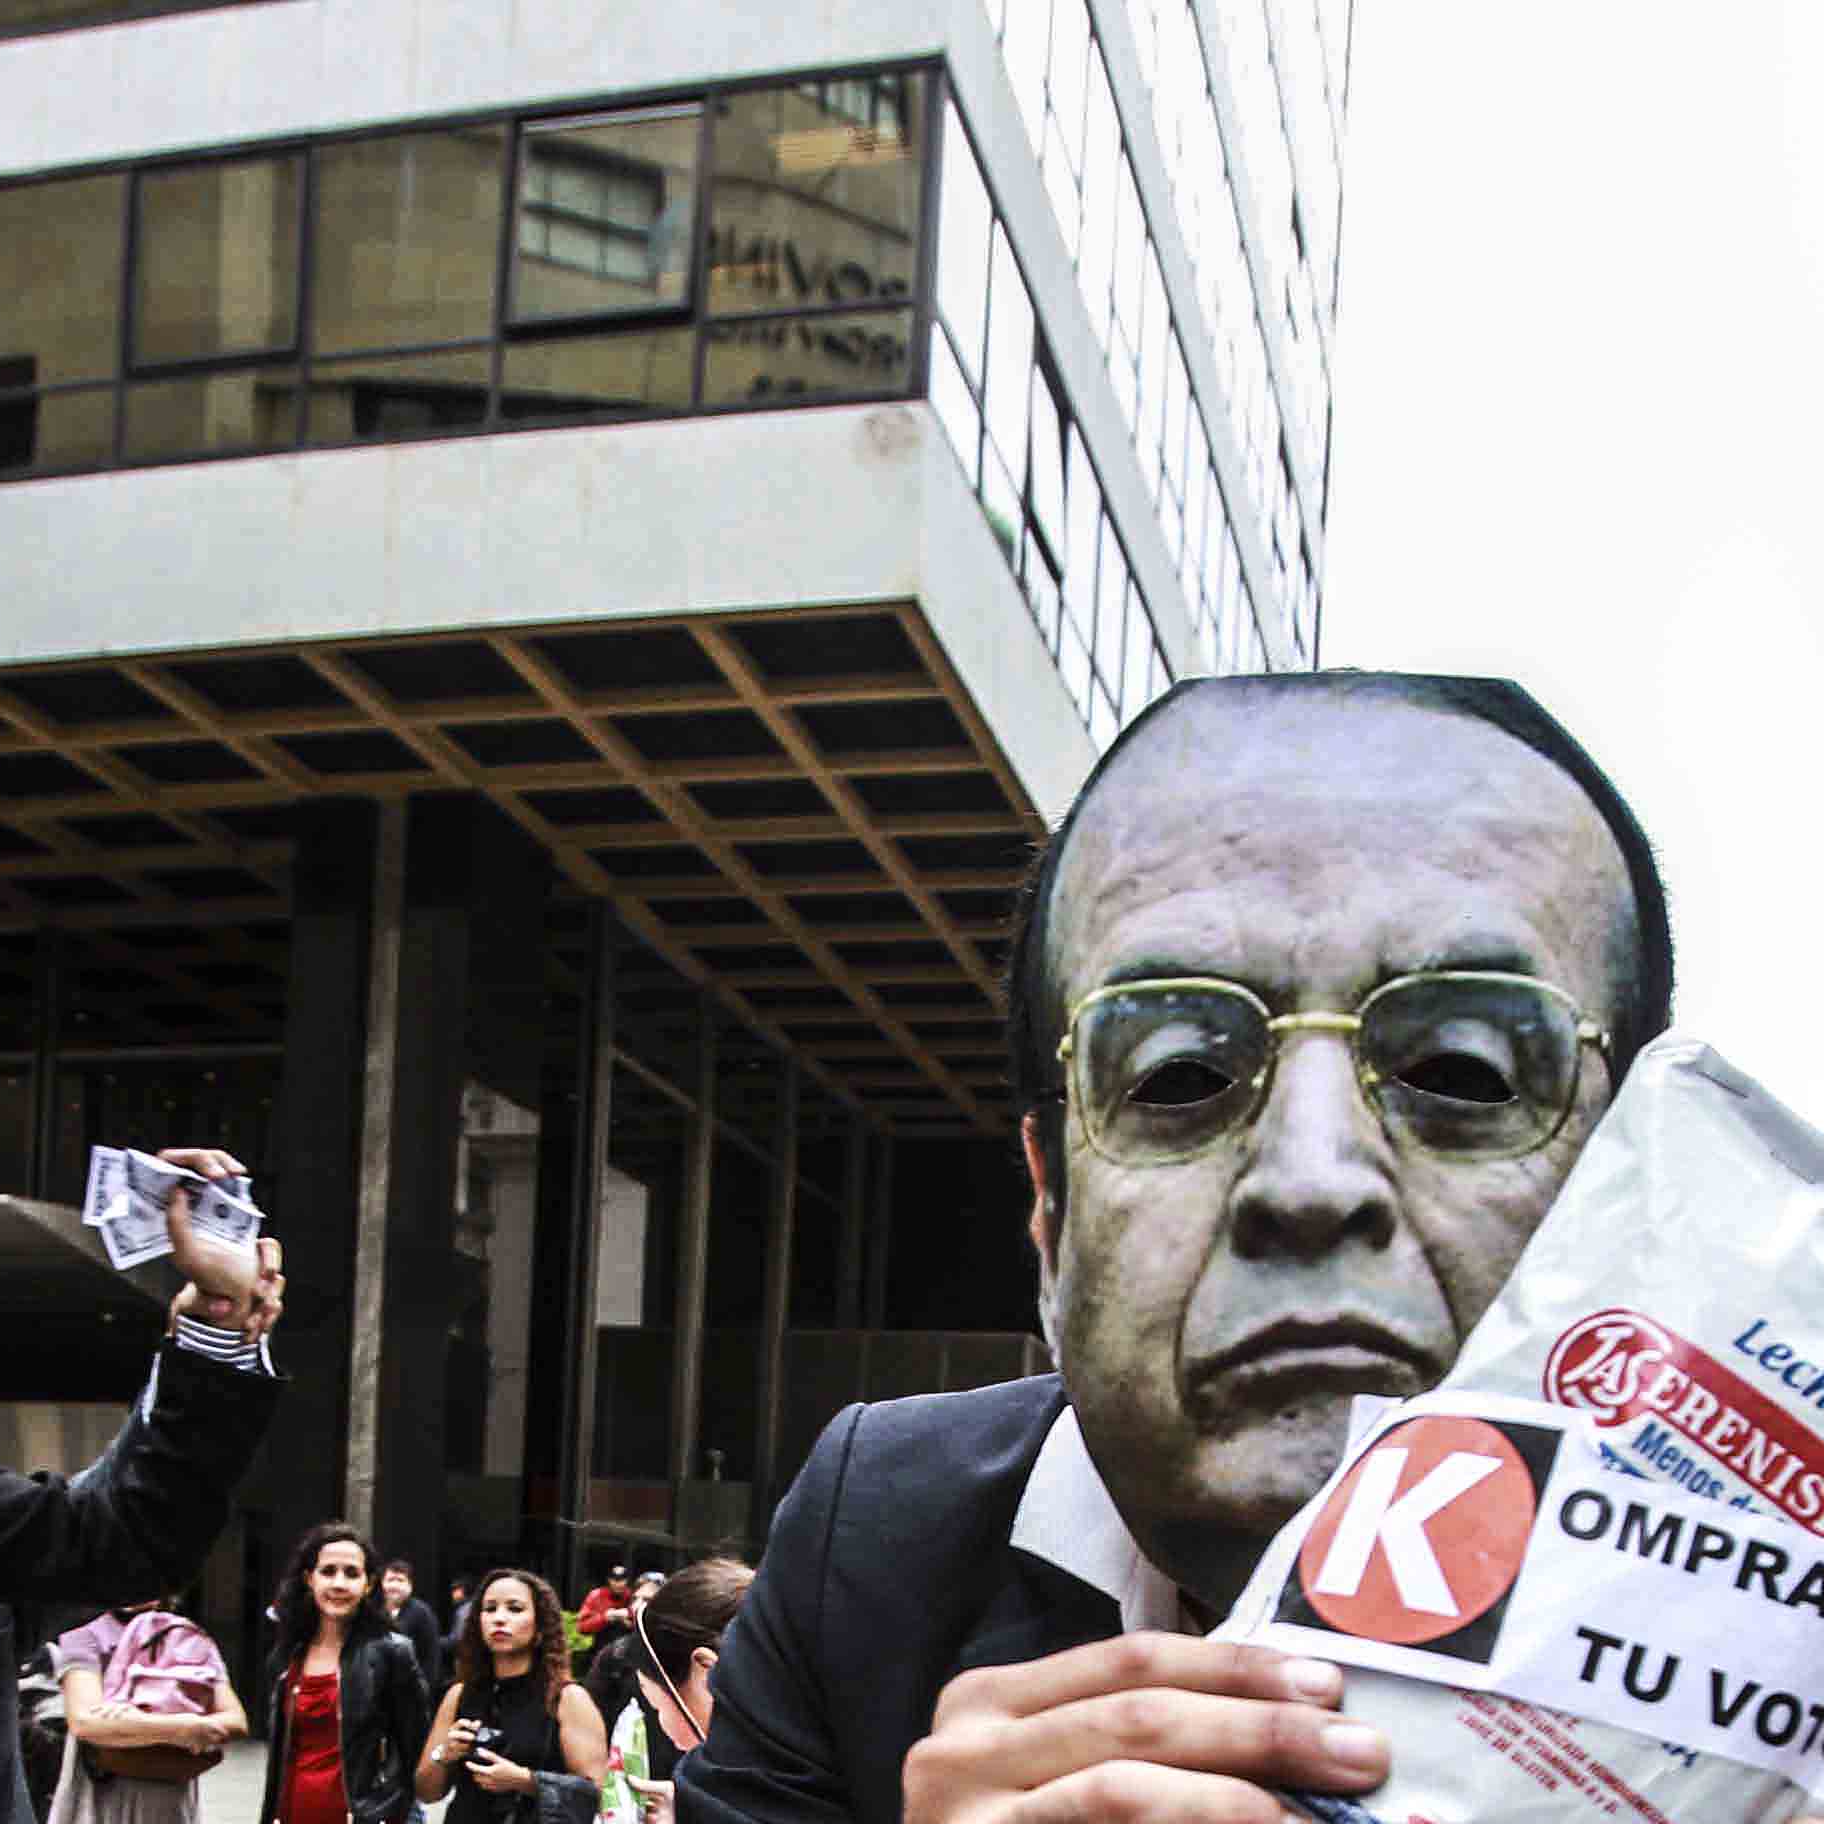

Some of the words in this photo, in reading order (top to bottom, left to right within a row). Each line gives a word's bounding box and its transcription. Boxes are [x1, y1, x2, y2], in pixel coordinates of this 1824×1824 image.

[1632, 1421, 1725, 1501] Menos
[1312, 1446, 1504, 1618] K
[1574, 1626, 1681, 1704] TU
